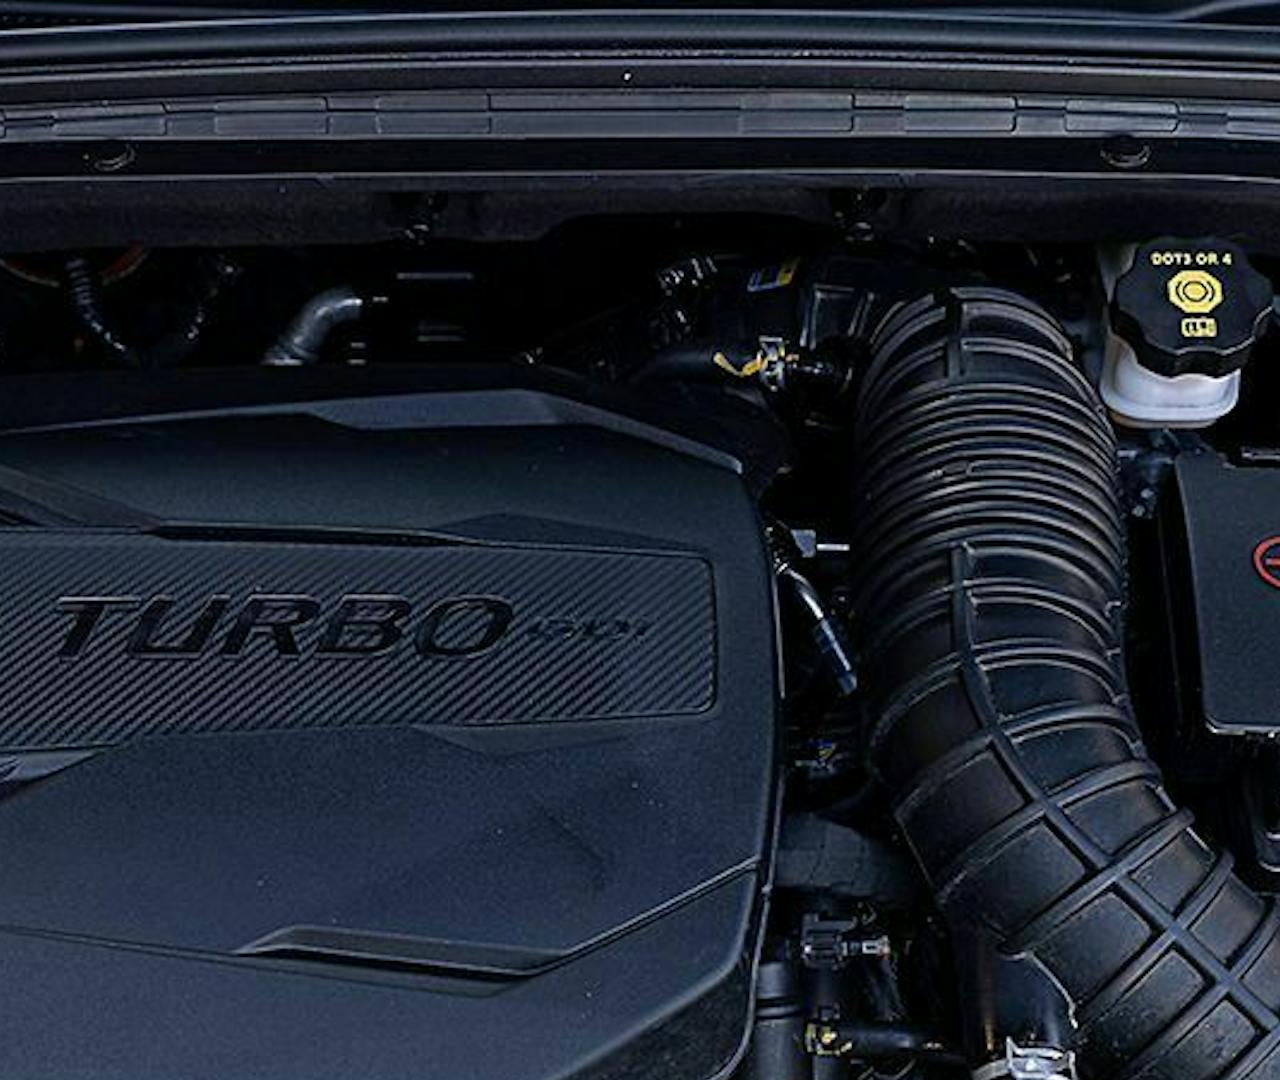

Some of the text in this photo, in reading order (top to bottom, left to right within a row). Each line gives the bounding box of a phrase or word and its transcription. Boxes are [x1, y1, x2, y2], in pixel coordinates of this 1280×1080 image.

[1195, 253, 1220, 265] OR
[1222, 253, 1232, 265] 4
[56, 593, 515, 661] TURBO
